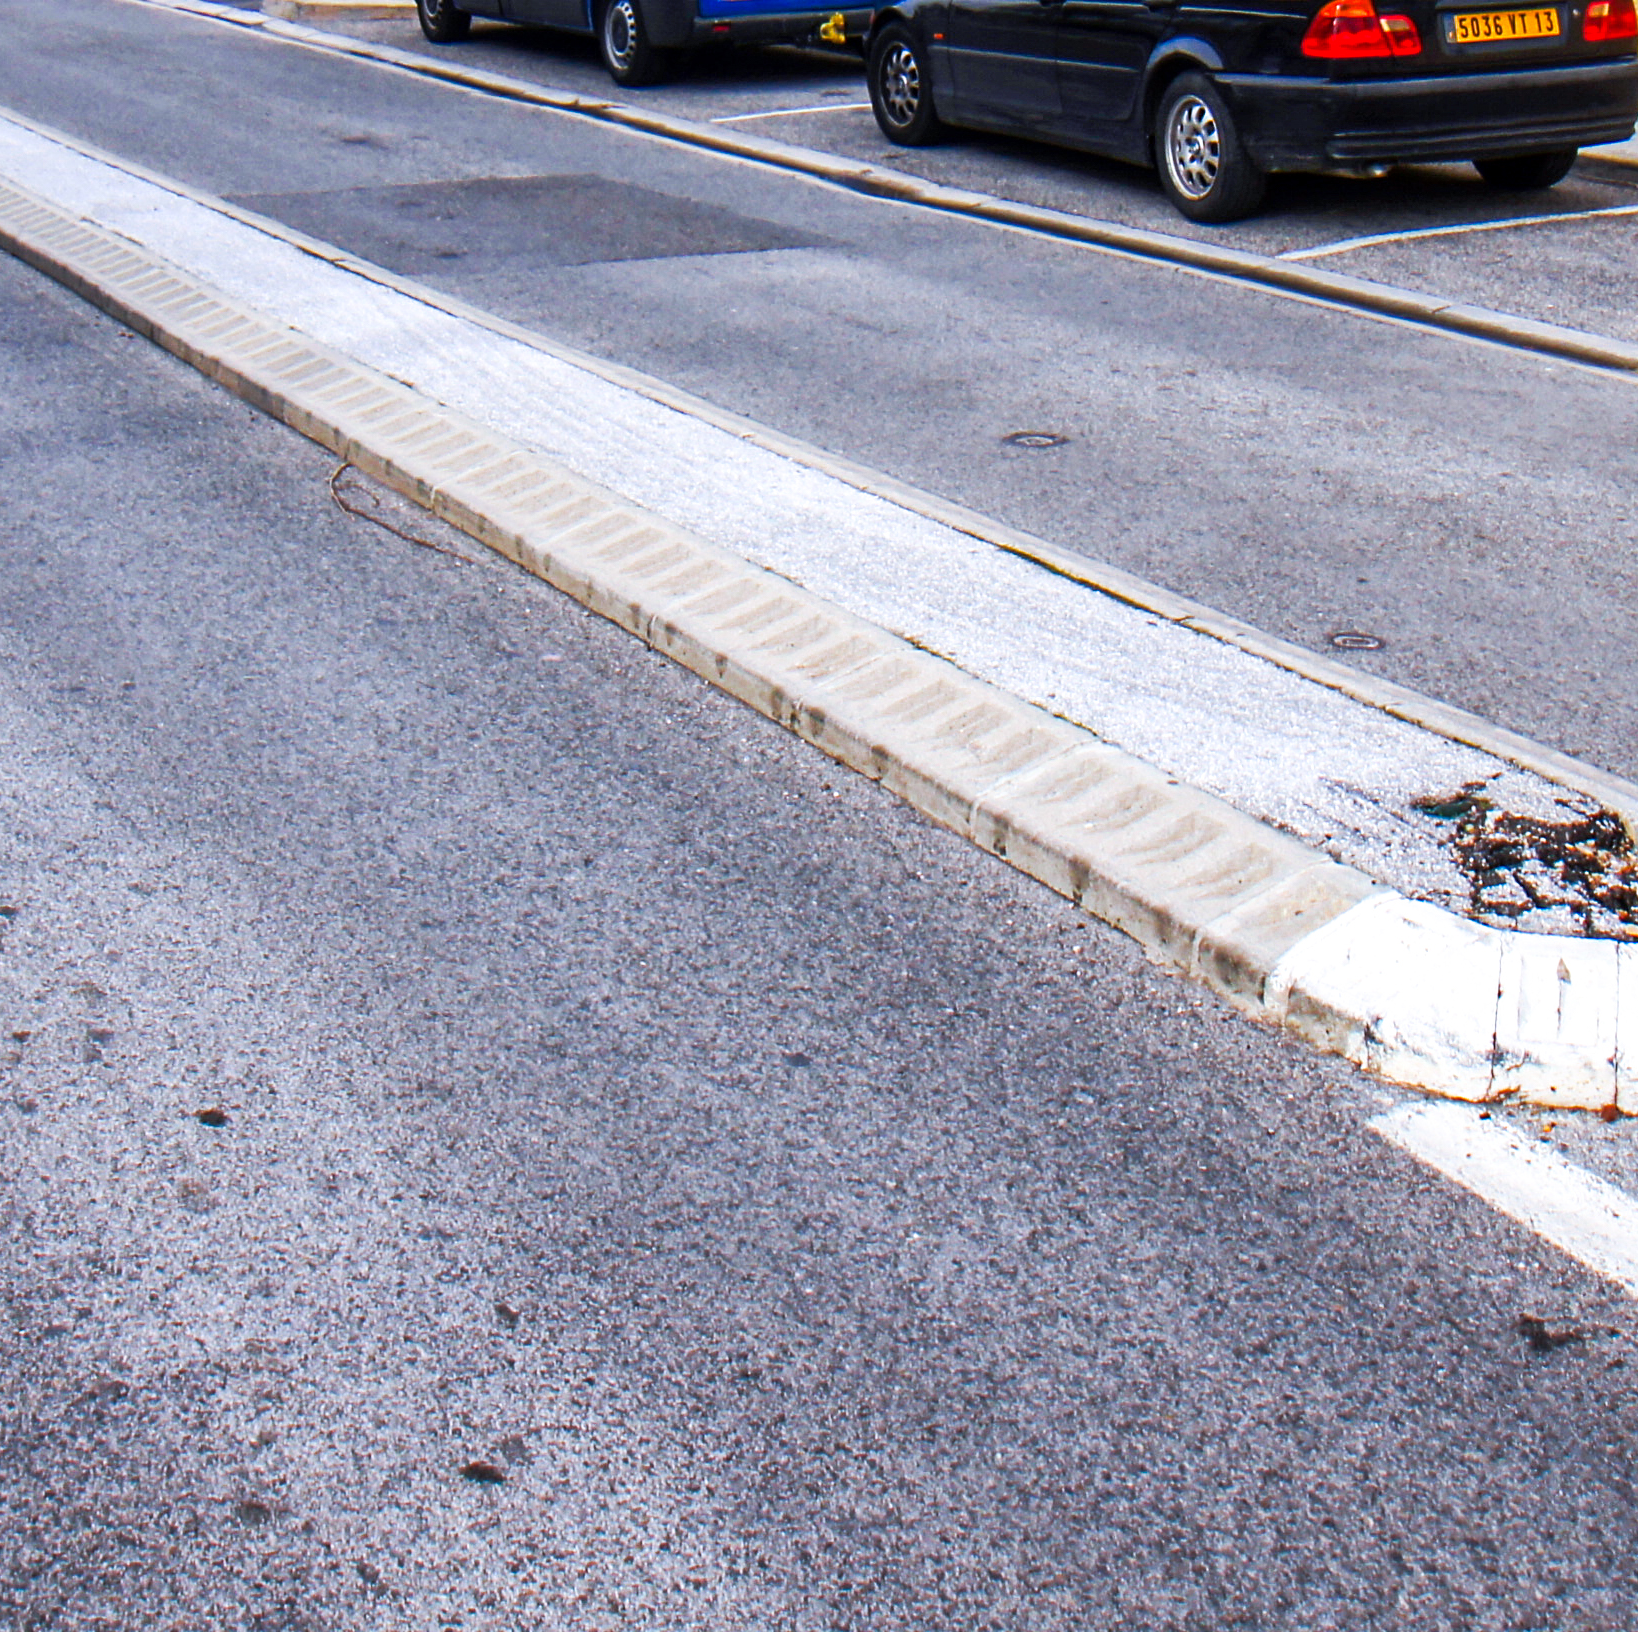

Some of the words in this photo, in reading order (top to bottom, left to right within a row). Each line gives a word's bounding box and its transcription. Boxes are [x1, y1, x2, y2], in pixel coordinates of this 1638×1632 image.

[1458, 15, 1503, 38] 5036
[1508, 13, 1527, 35] VT
[1534, 11, 1554, 33] 13
